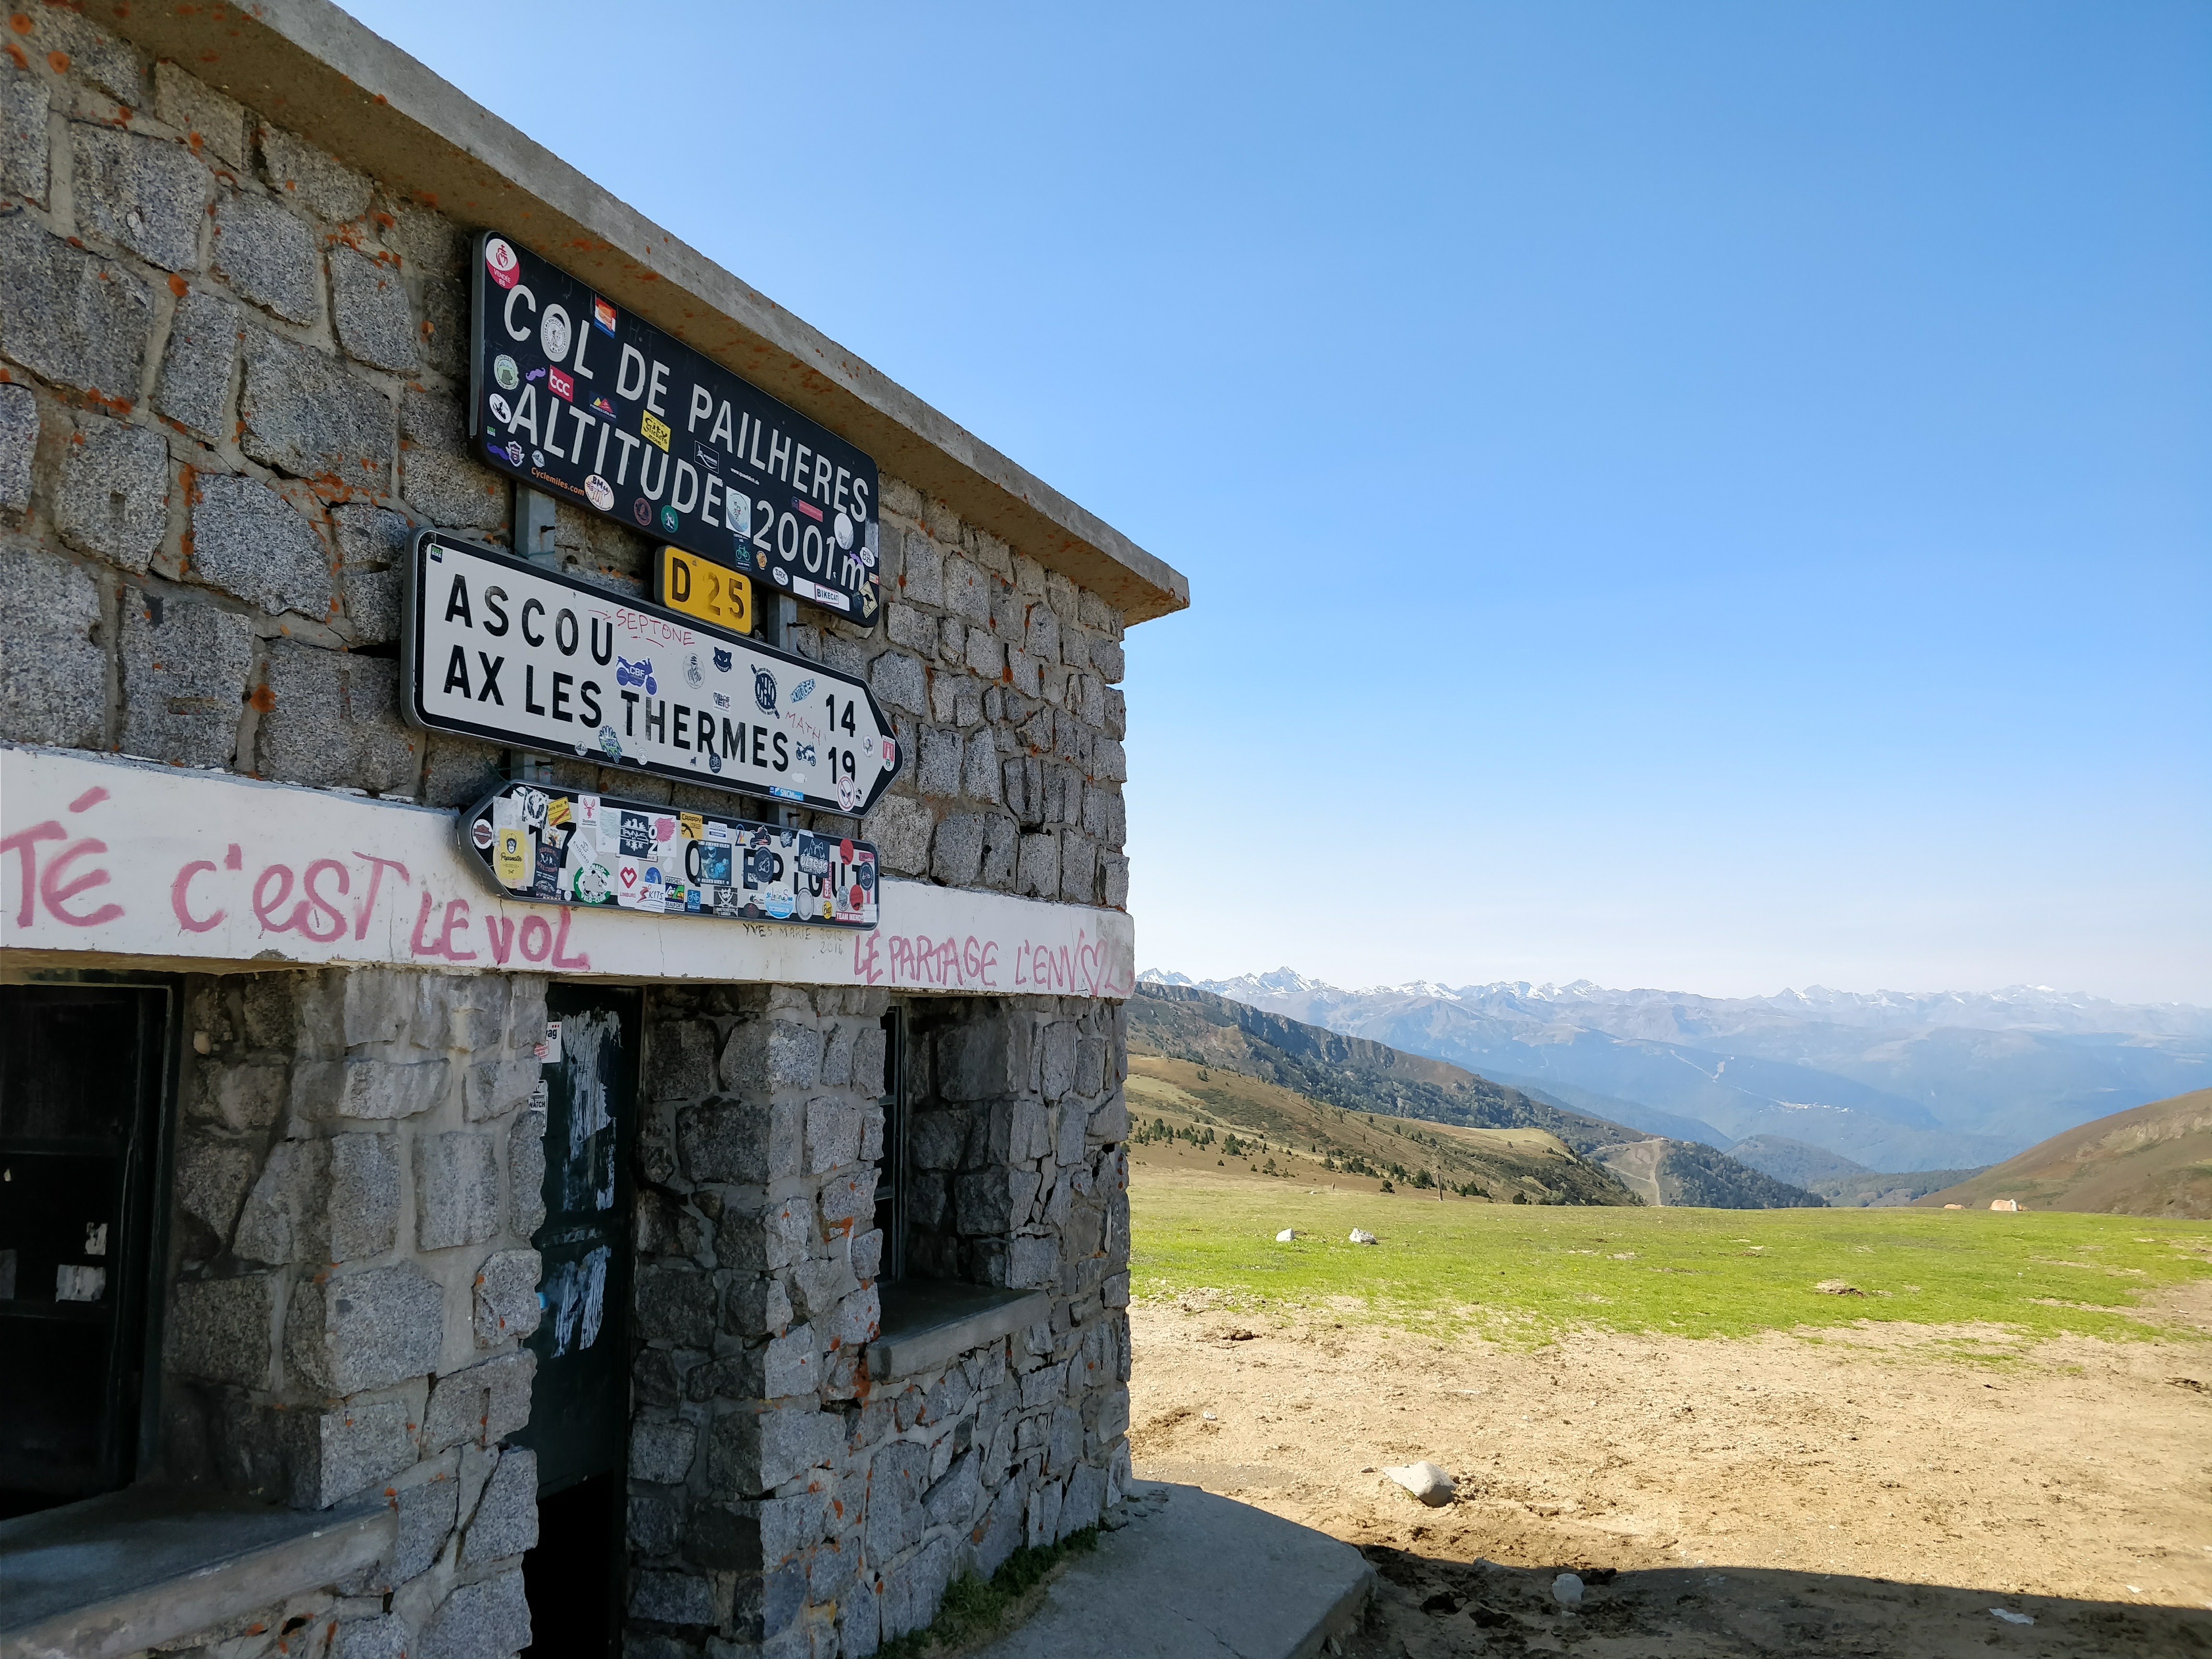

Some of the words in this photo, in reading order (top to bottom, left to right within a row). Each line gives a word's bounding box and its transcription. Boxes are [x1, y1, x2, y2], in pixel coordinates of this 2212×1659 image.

[494, 269, 511, 284] VENDÉE
[499, 278, 505, 287] 85
[504, 284, 594, 379] COL
[616, 343, 670, 417] DE
[687, 383, 869, 522] PAILHERES
[645, 418, 668, 438] City
[507, 383, 723, 527] ALTITUDE
[531, 467, 584, 496] Cyclemiles.com
[672, 557, 690, 602] D
[703, 572, 744, 620] 25
[775, 568, 786, 580] SRX
[817, 588, 839, 601] BIKECAT
[445, 574, 613, 666] ASCOU
[616, 608, 695, 646] SEPTONE
[630, 666, 645, 677] CBF
[444, 644, 505, 706] AX
[526, 664, 602, 728] LES
[621, 690, 789, 772] THERMES
[826, 694, 856, 738] 14
[828, 746, 856, 785] 19
[781, 789, 794, 798] SNCM
[682, 814, 701, 823] CRAPPY
[529, 821, 577, 869] 17
[685, 840, 864, 898] QERIGUT
[573, 841, 589, 864] ENDURO
[800, 854, 829, 875] ULTRAS
[486, 905, 591, 970] VOL
[743, 923, 772, 938] YVES
[854, 929, 883, 986] LE
[889, 935, 999, 986] PARTAGE
